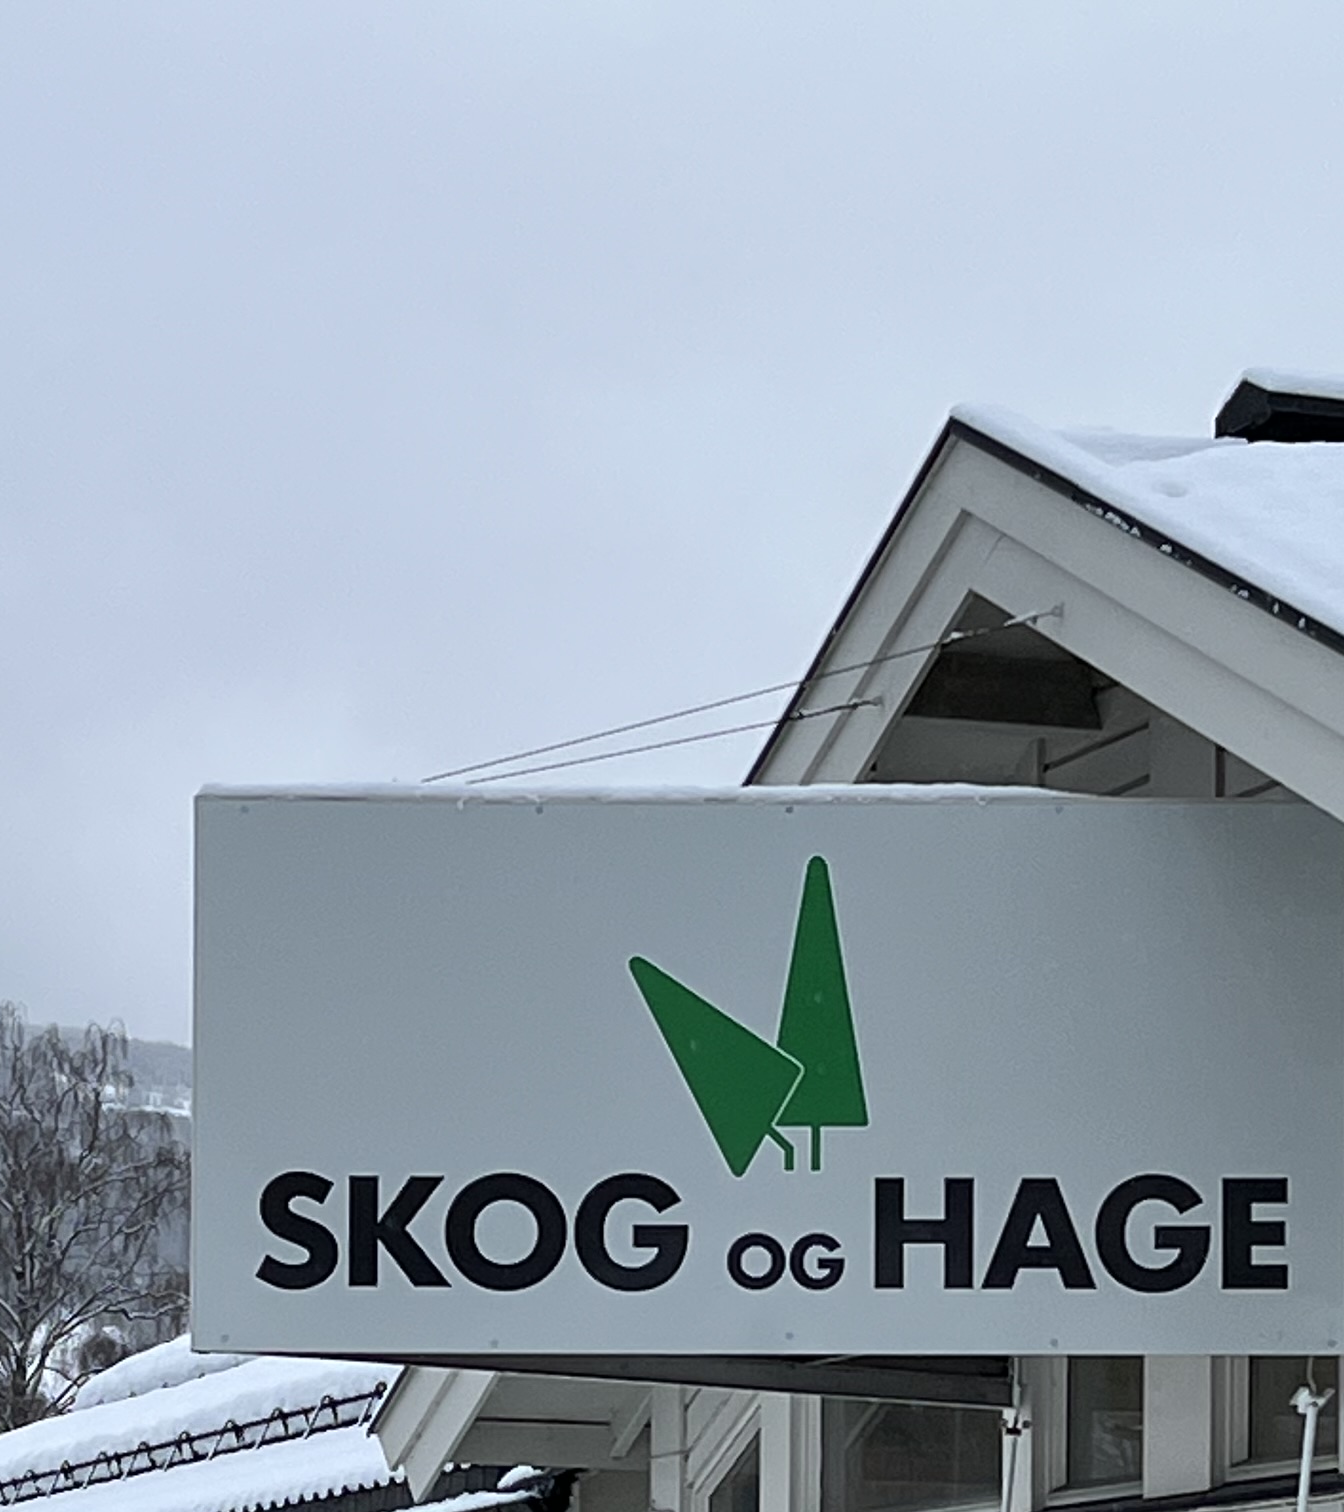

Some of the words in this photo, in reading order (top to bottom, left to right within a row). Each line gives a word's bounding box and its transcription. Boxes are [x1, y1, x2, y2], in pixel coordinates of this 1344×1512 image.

[256, 1171, 690, 1293] SKOG
[726, 1231, 846, 1291] OG
[874, 1174, 1290, 1294] HAGE
